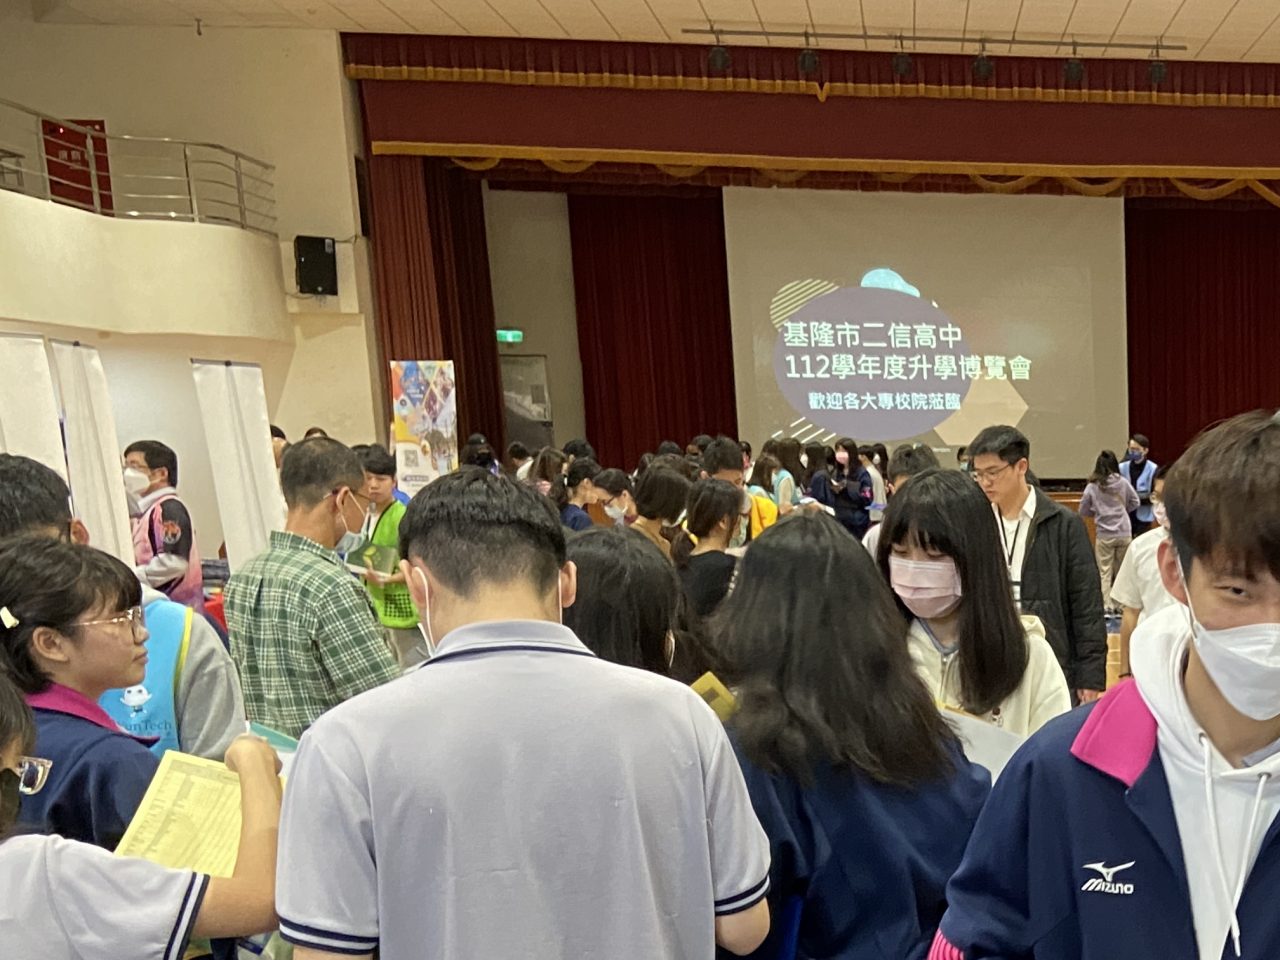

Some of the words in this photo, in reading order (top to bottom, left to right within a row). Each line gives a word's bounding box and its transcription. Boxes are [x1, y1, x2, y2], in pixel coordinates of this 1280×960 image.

[783, 321, 962, 349] 基隆市二信高中
[784, 354, 1032, 381] 112學年度升學博覽會
[808, 392, 961, 410] 歡迎各大專校院蒞臨
